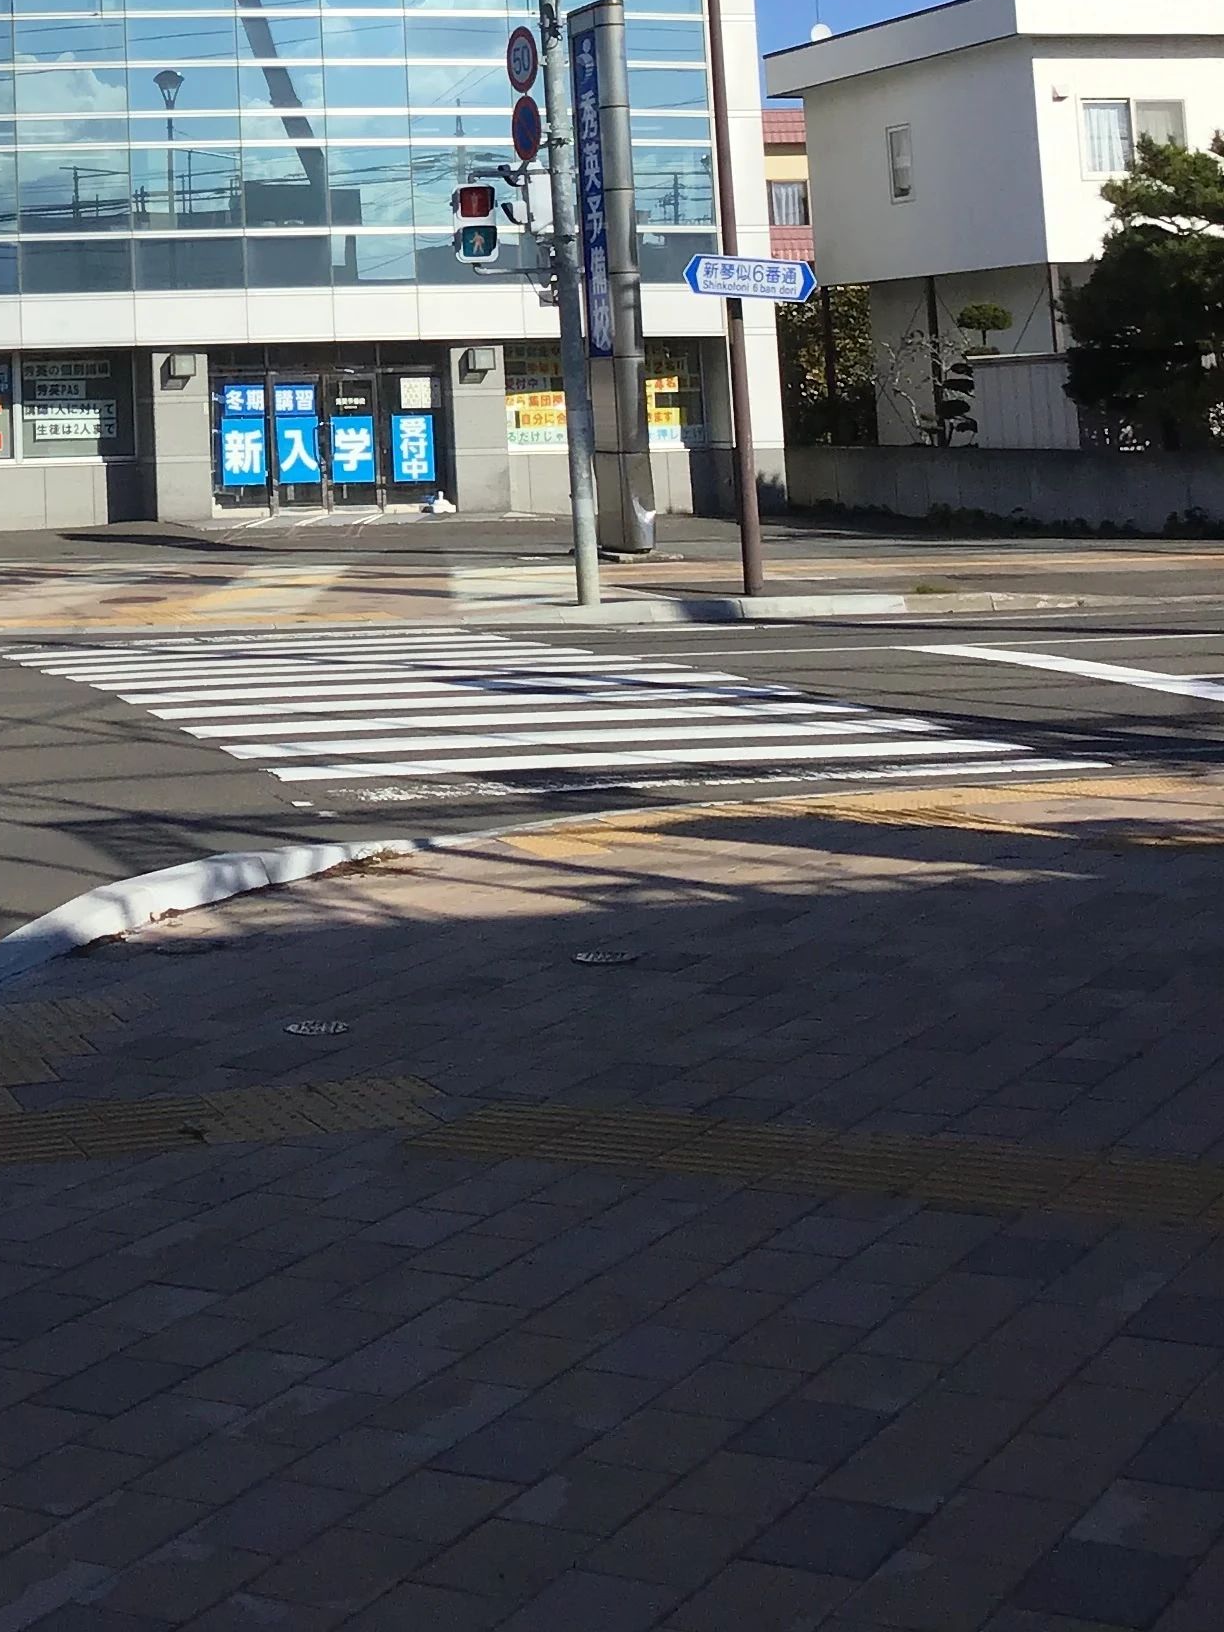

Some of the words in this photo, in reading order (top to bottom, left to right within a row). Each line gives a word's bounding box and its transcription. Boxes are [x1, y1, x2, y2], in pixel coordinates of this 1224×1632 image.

[513, 46, 530, 75] 50
[579, 89, 612, 352] 秀英予備校
[703, 262, 797, 285] 新琴似6番通
[702, 279, 750, 292] Shinkotoni
[752, 283, 758, 292] 6
[759, 283, 776, 293] ban
[779, 285, 797, 295] dori
[225, 389, 313, 412] 冬期講習
[398, 418, 428, 479] 受付中
